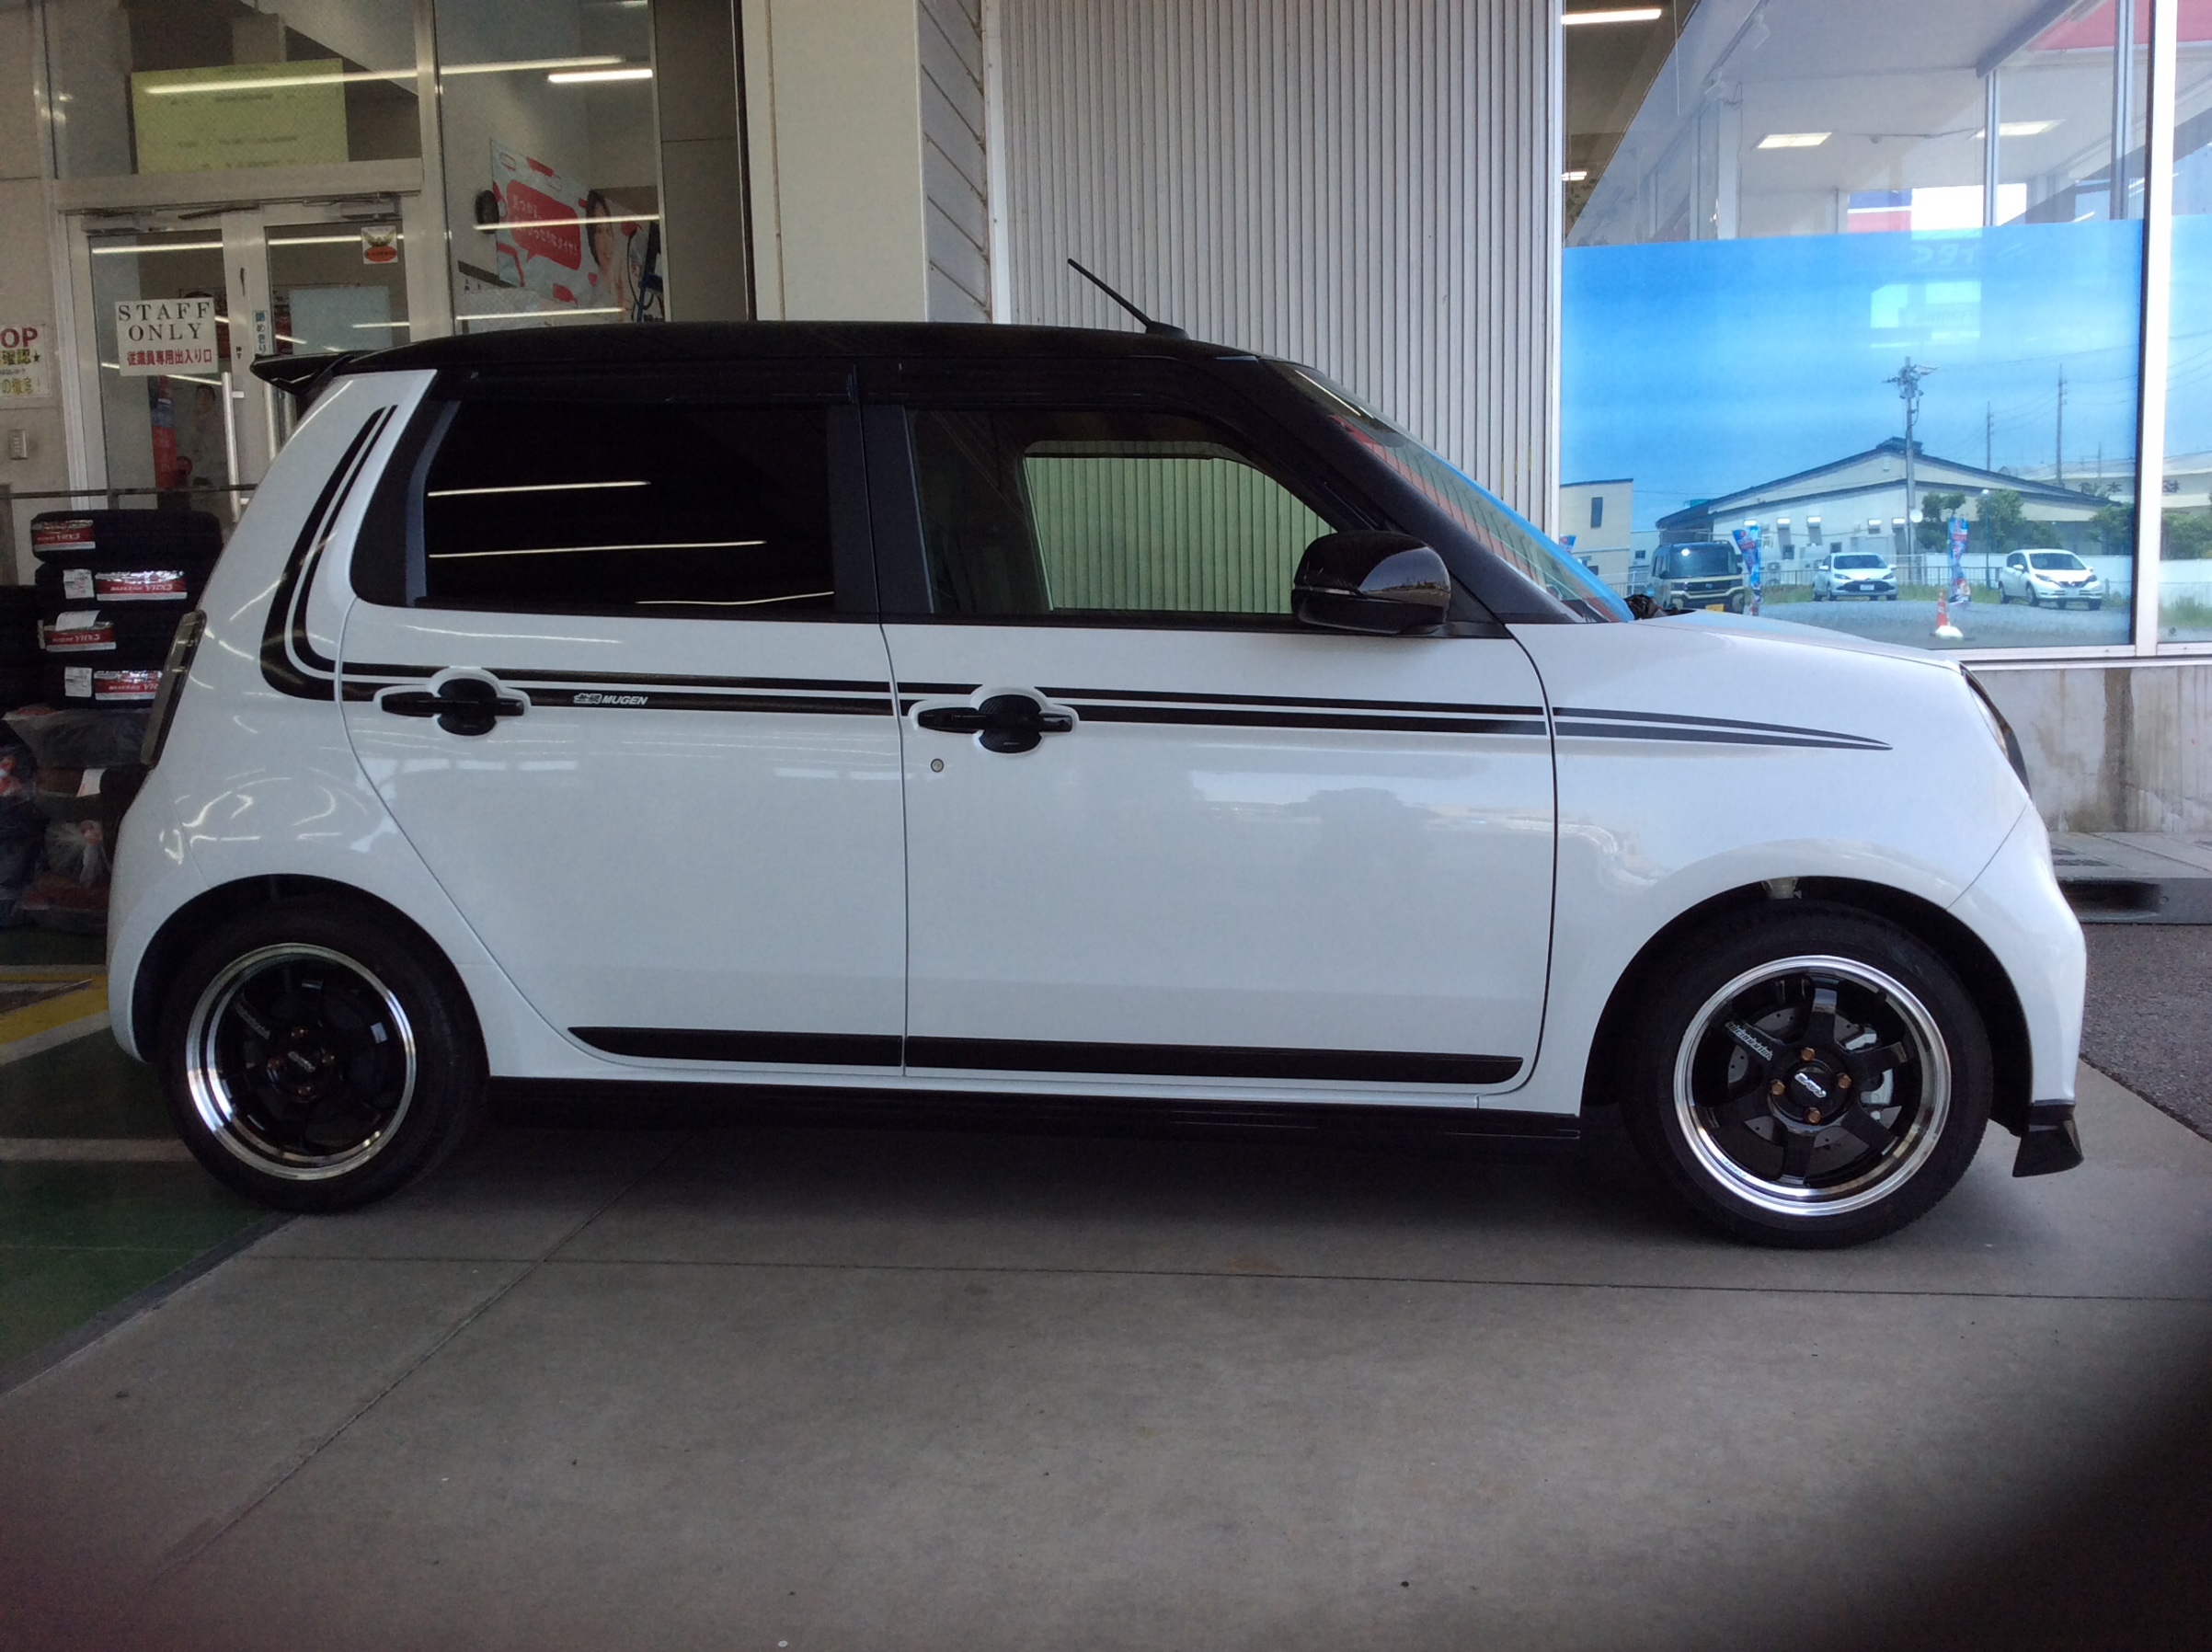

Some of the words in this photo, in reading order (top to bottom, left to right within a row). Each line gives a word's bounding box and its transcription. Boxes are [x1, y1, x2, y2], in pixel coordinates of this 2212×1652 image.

[118, 302, 211, 321] STAFF
[0, 327, 39, 349] OP
[128, 323, 201, 341] ONLY
[127, 349, 212, 366] 従業員専用出入り口
[602, 694, 649, 706] MUGEN
